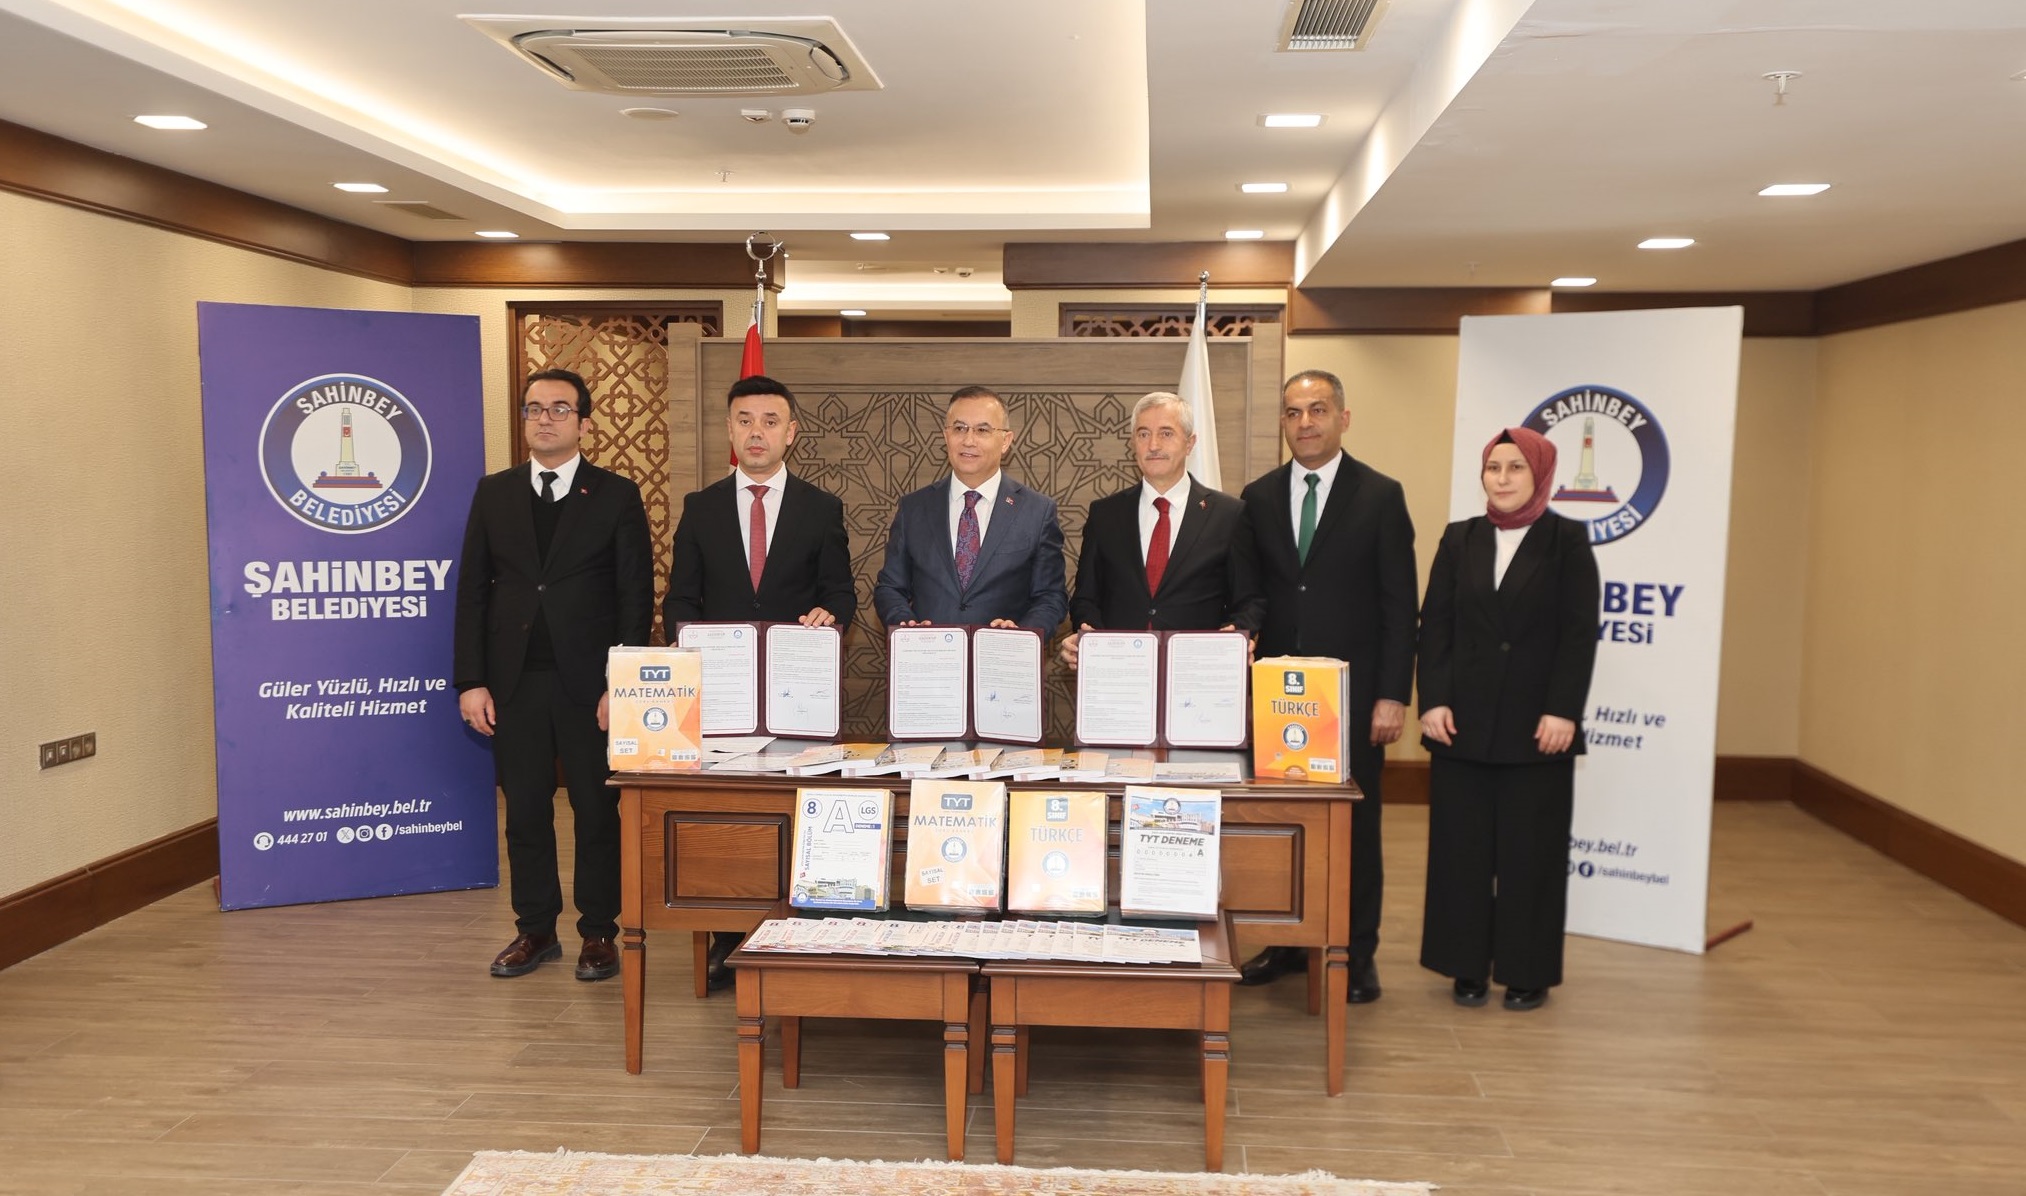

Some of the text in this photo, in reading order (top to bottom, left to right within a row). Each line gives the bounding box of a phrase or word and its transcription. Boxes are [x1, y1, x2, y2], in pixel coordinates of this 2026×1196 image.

[289, 488, 407, 526] BELEDİYESİ
[1586, 503, 1643, 543] İYESİ
[641, 669, 669, 679] TYT
[1287, 673, 1300, 686] 8.
[258, 676, 447, 698] Güler Yüzlü, Hızlı ve
[614, 685, 696, 698] MATEMATİK
[286, 700, 428, 720] Kaliteli Hizmet
[1271, 698, 1319, 717] TÜRKÇE
[1595, 706, 1666, 728] Hızlı ve
[944, 797, 971, 807] TYT
[1051, 799, 1063, 812] 8.
[284, 799, 432, 822] www.sahinbey.bel.tr
[823, 800, 855, 833] A
[861, 806, 876, 815] LGS
[394, 820, 463, 836] /sahinbeybel
[913, 814, 997, 828] MATEMATİK
[277, 831, 328, 845] 444 27 01
[1030, 825, 1083, 843] TÜRKÇE
[1140, 834, 1205, 847] TYT DENEME
[1197, 849, 1204, 857] A
[927, 876, 941, 884] SET
